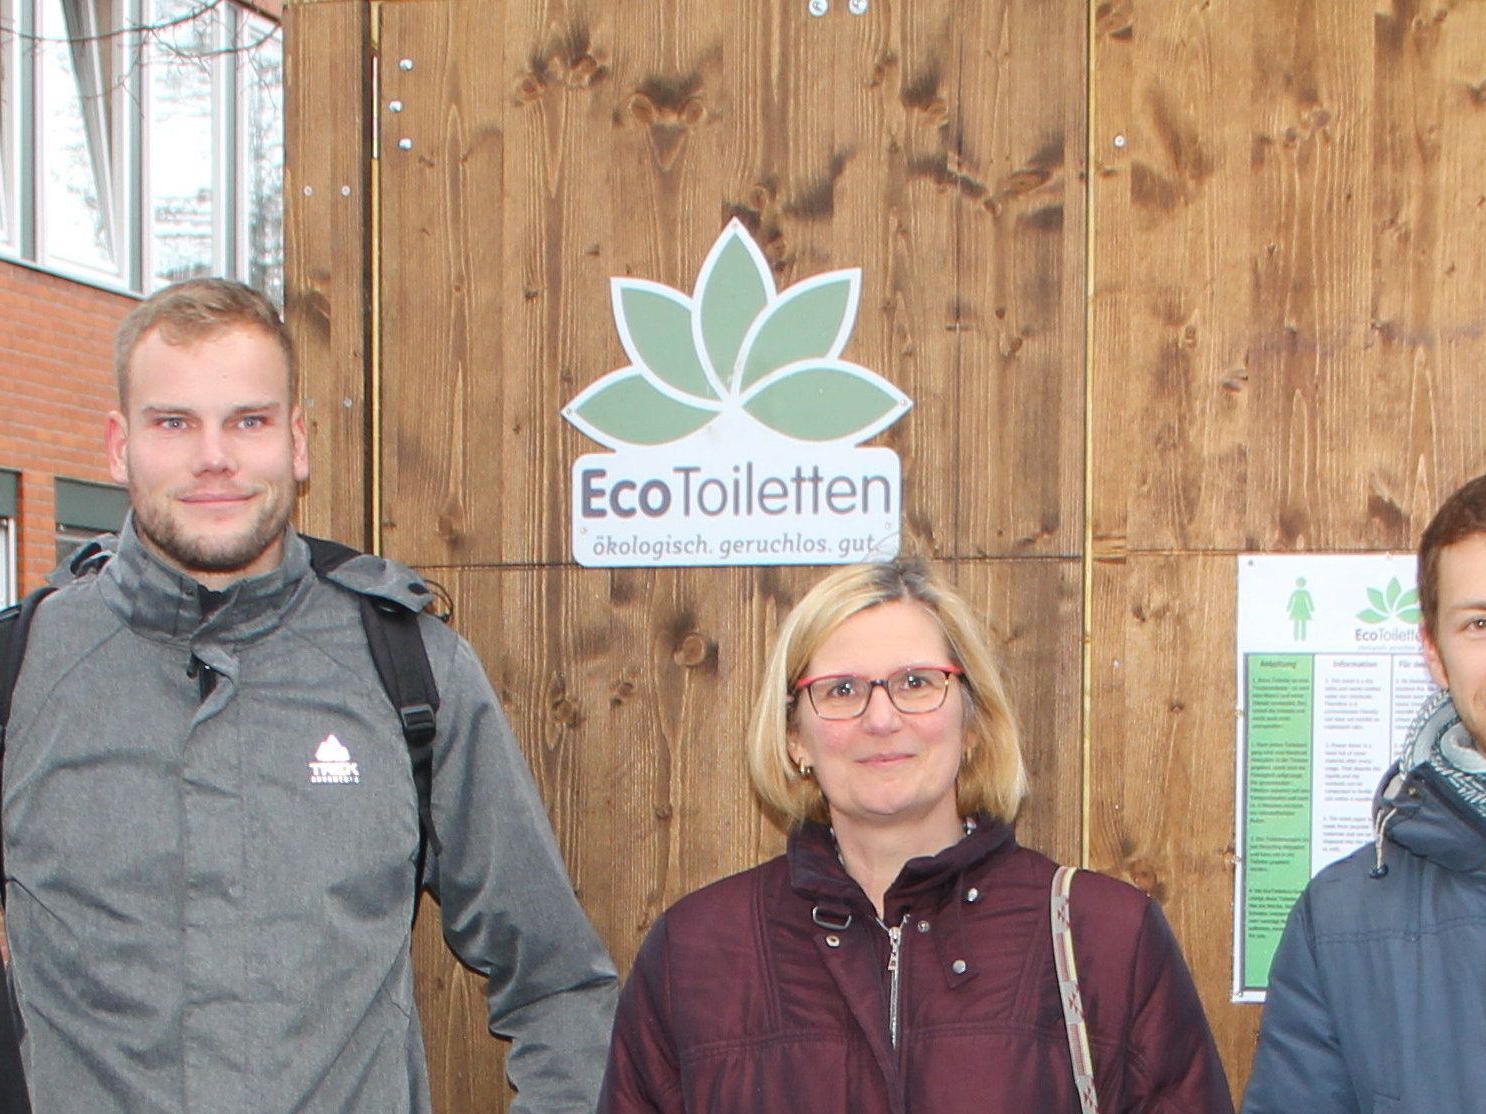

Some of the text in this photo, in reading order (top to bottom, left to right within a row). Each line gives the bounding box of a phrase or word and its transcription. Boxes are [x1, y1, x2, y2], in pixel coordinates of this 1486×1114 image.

[580, 461, 892, 519] EcoToiletten
[592, 533, 880, 561] ökologisch. geruchlos. gut.
[308, 762, 360, 776] TREK
